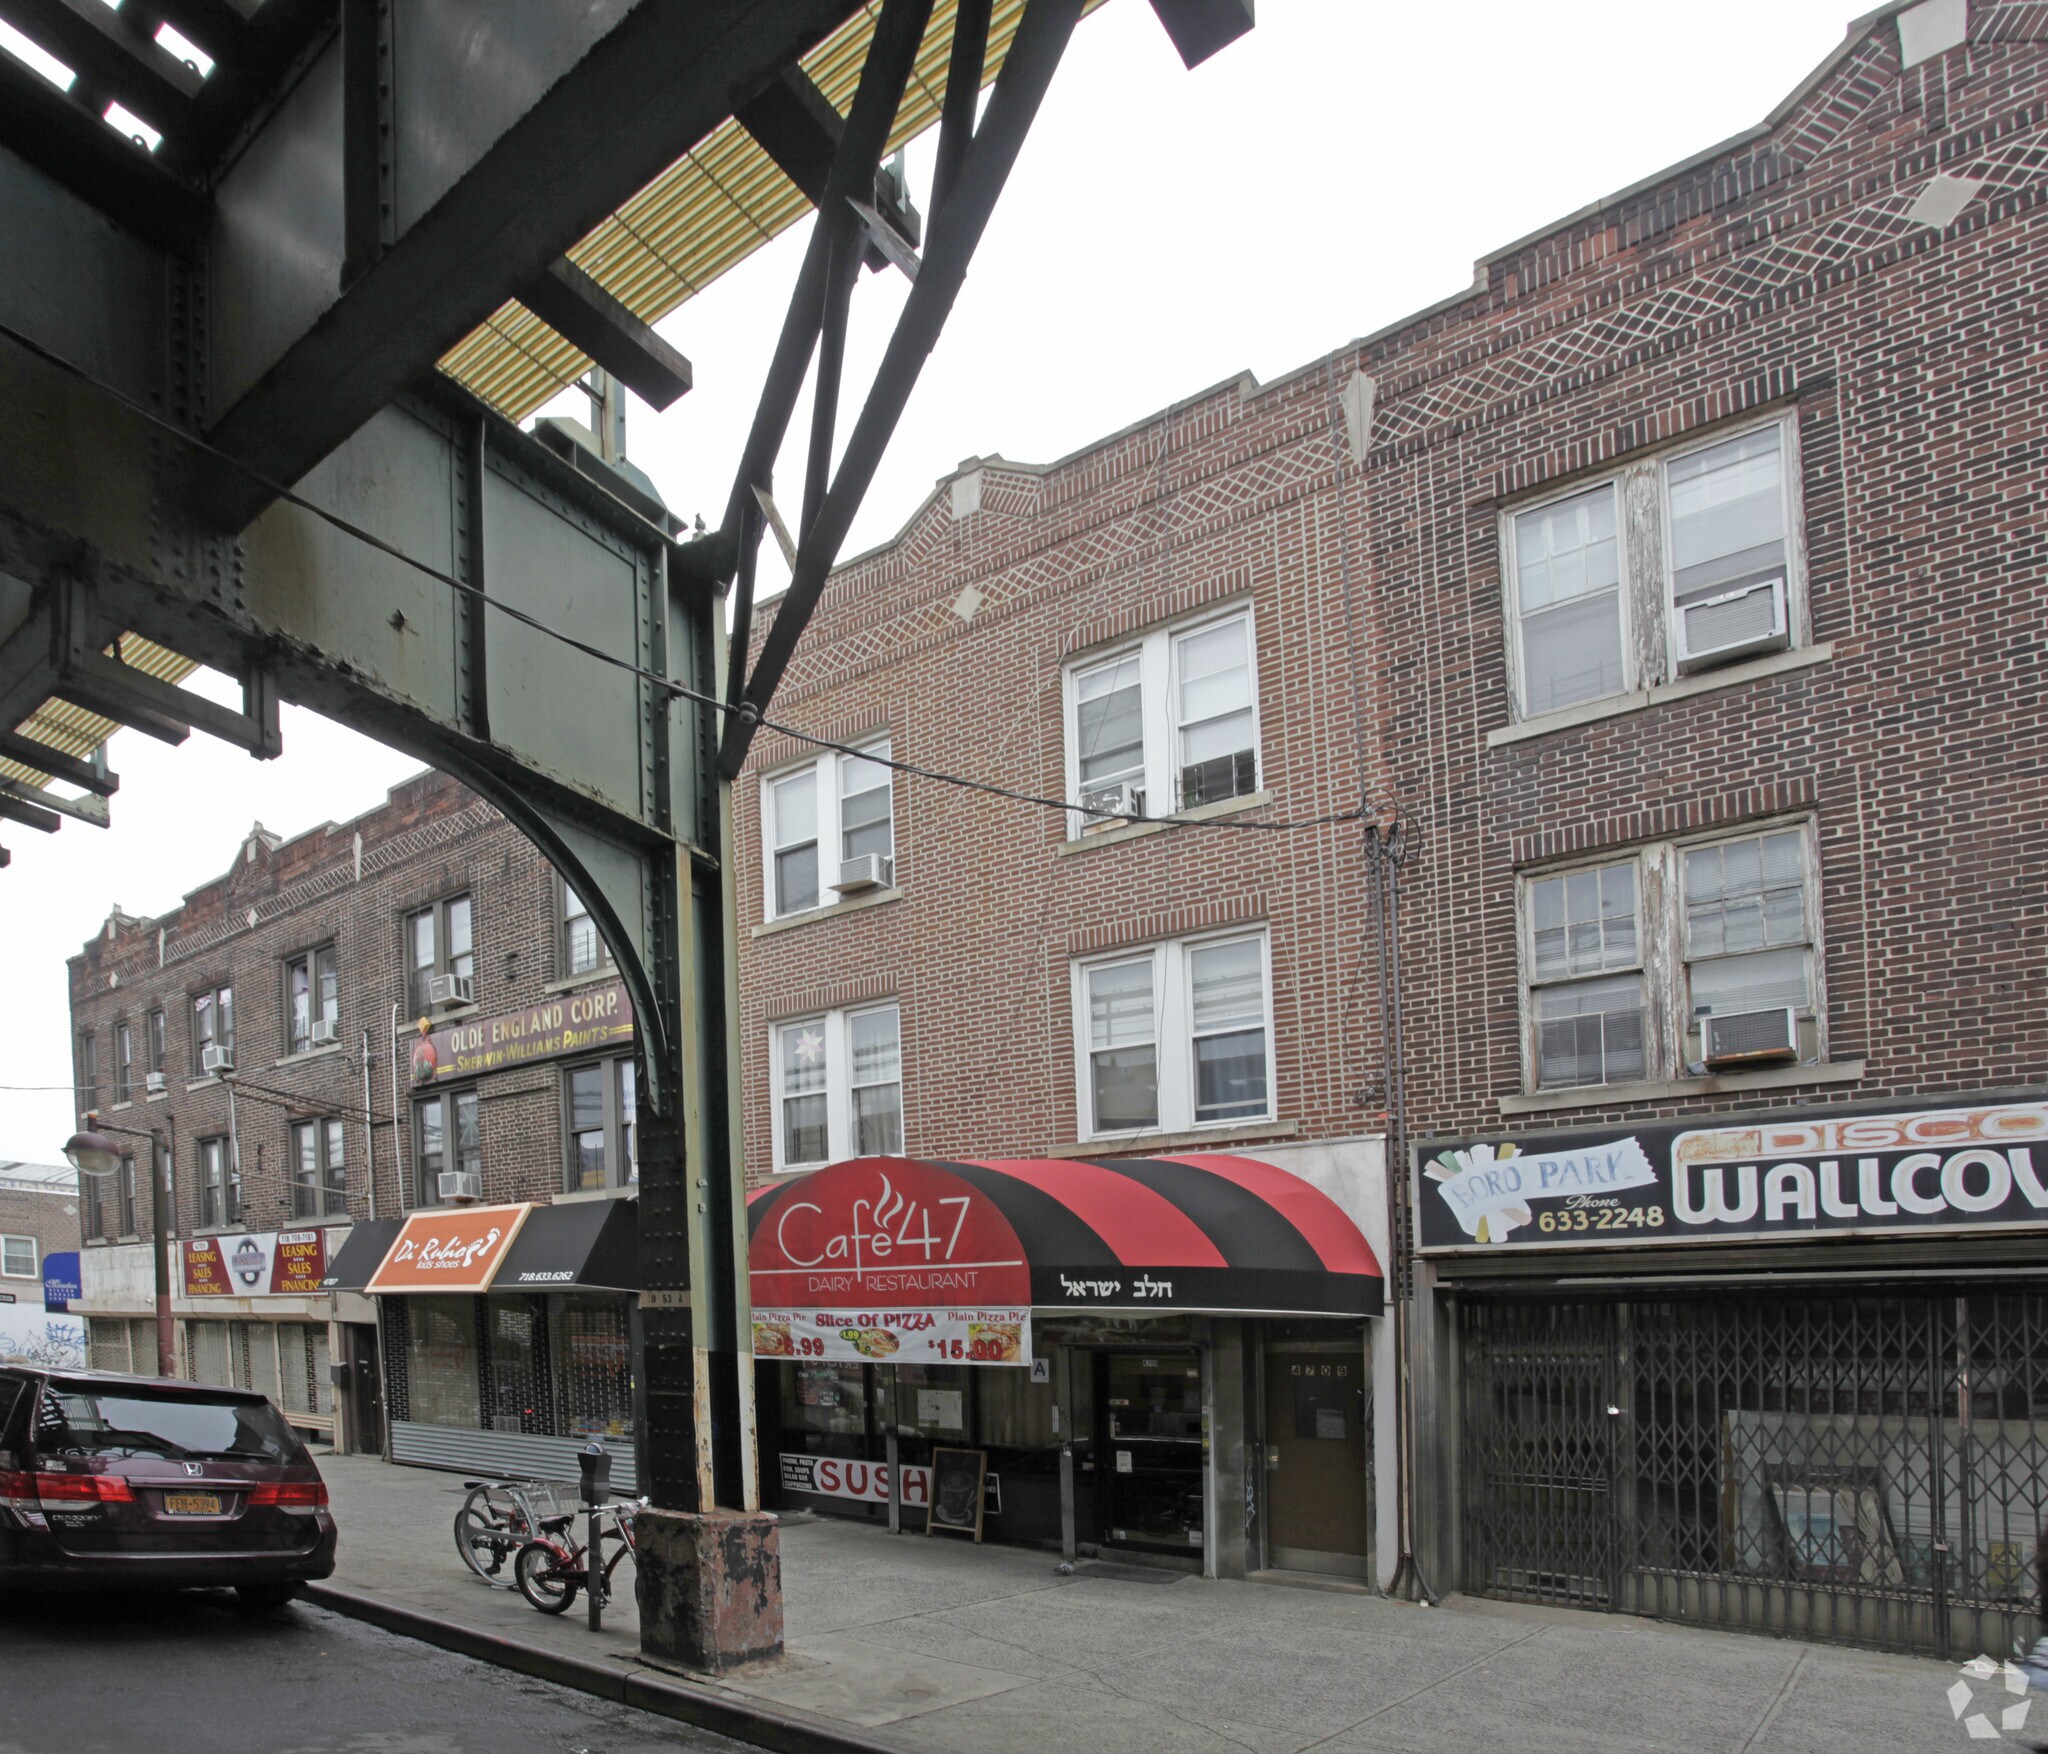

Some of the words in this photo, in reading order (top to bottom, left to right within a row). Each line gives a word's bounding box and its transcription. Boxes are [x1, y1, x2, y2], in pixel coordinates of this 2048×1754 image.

[452, 1028, 484, 1053] OLDE
[492, 1005, 563, 1043] ENGLAND
[571, 991, 618, 1024] CORP.
[562, 1026, 608, 1049] PAINTS
[1537, 1151, 1634, 1189] PARK
[1564, 1194, 1621, 1209] Phone
[1539, 1206, 1665, 1232] 633-2248
[189, 1251, 216, 1264] LEASING
[281, 1244, 317, 1258] LEASING
[394, 1240, 414, 1263] Di
[287, 1262, 311, 1275] SALES
[416, 1260, 433, 1269] kids
[434, 1259, 459, 1269] shoes
[193, 1267, 212, 1279] SALES
[518, 1271, 574, 1281] 718.633.6262
[188, 1283, 221, 1294] FINANCING
[281, 1279, 321, 1292] FINANCIN
[808, 1276, 854, 1292] DAIRY
[866, 1272, 978, 1291] RESTAURANT
[1060, 1273, 1121, 1297] ישראל
[1133, 1274, 1172, 1298] חלב
[752, 1313, 767, 1321] lain
[768, 1313, 790, 1322] Pizza
[793, 1313, 807, 1321] Pie
[815, 1313, 854, 1327] Slice
[858, 1313, 880, 1327] Of
[884, 1313, 936, 1331] PIZZA
[948, 1312, 975, 1321] Plain
[977, 1312, 1006, 1322] Pizza
[1009, 1312, 1027, 1321] Pie
[1034, 1361, 1046, 1376] A
